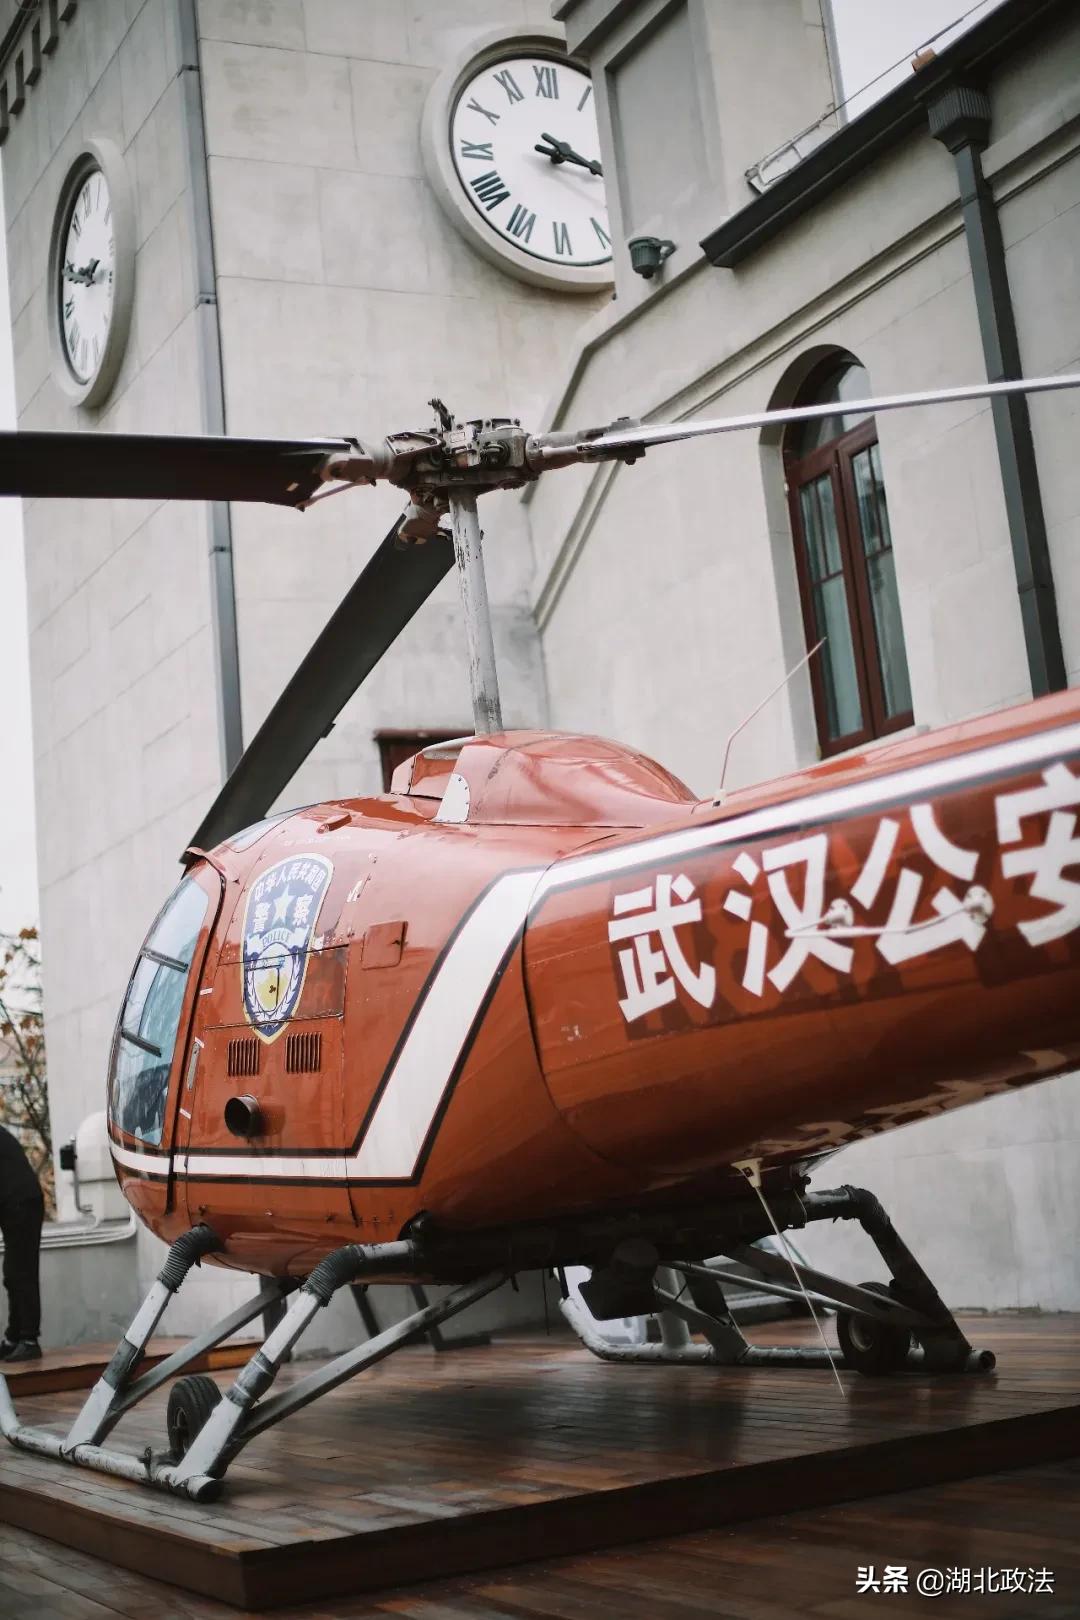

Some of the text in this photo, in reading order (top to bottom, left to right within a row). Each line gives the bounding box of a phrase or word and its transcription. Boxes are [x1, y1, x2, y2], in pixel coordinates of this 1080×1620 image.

[493, 69, 525, 104] XI
[533, 65, 559, 99] XII
[466, 97, 500, 126] X
[461, 139, 494, 161] IX
[470, 170, 511, 211] VIII
[506, 203, 536, 243] VII
[552, 221, 573, 256] VI
[254, 862, 326, 903] 中华人民共和国
[608, 762, 1080, 1022] 武汉公安
[263, 929, 290, 944] POLICE
